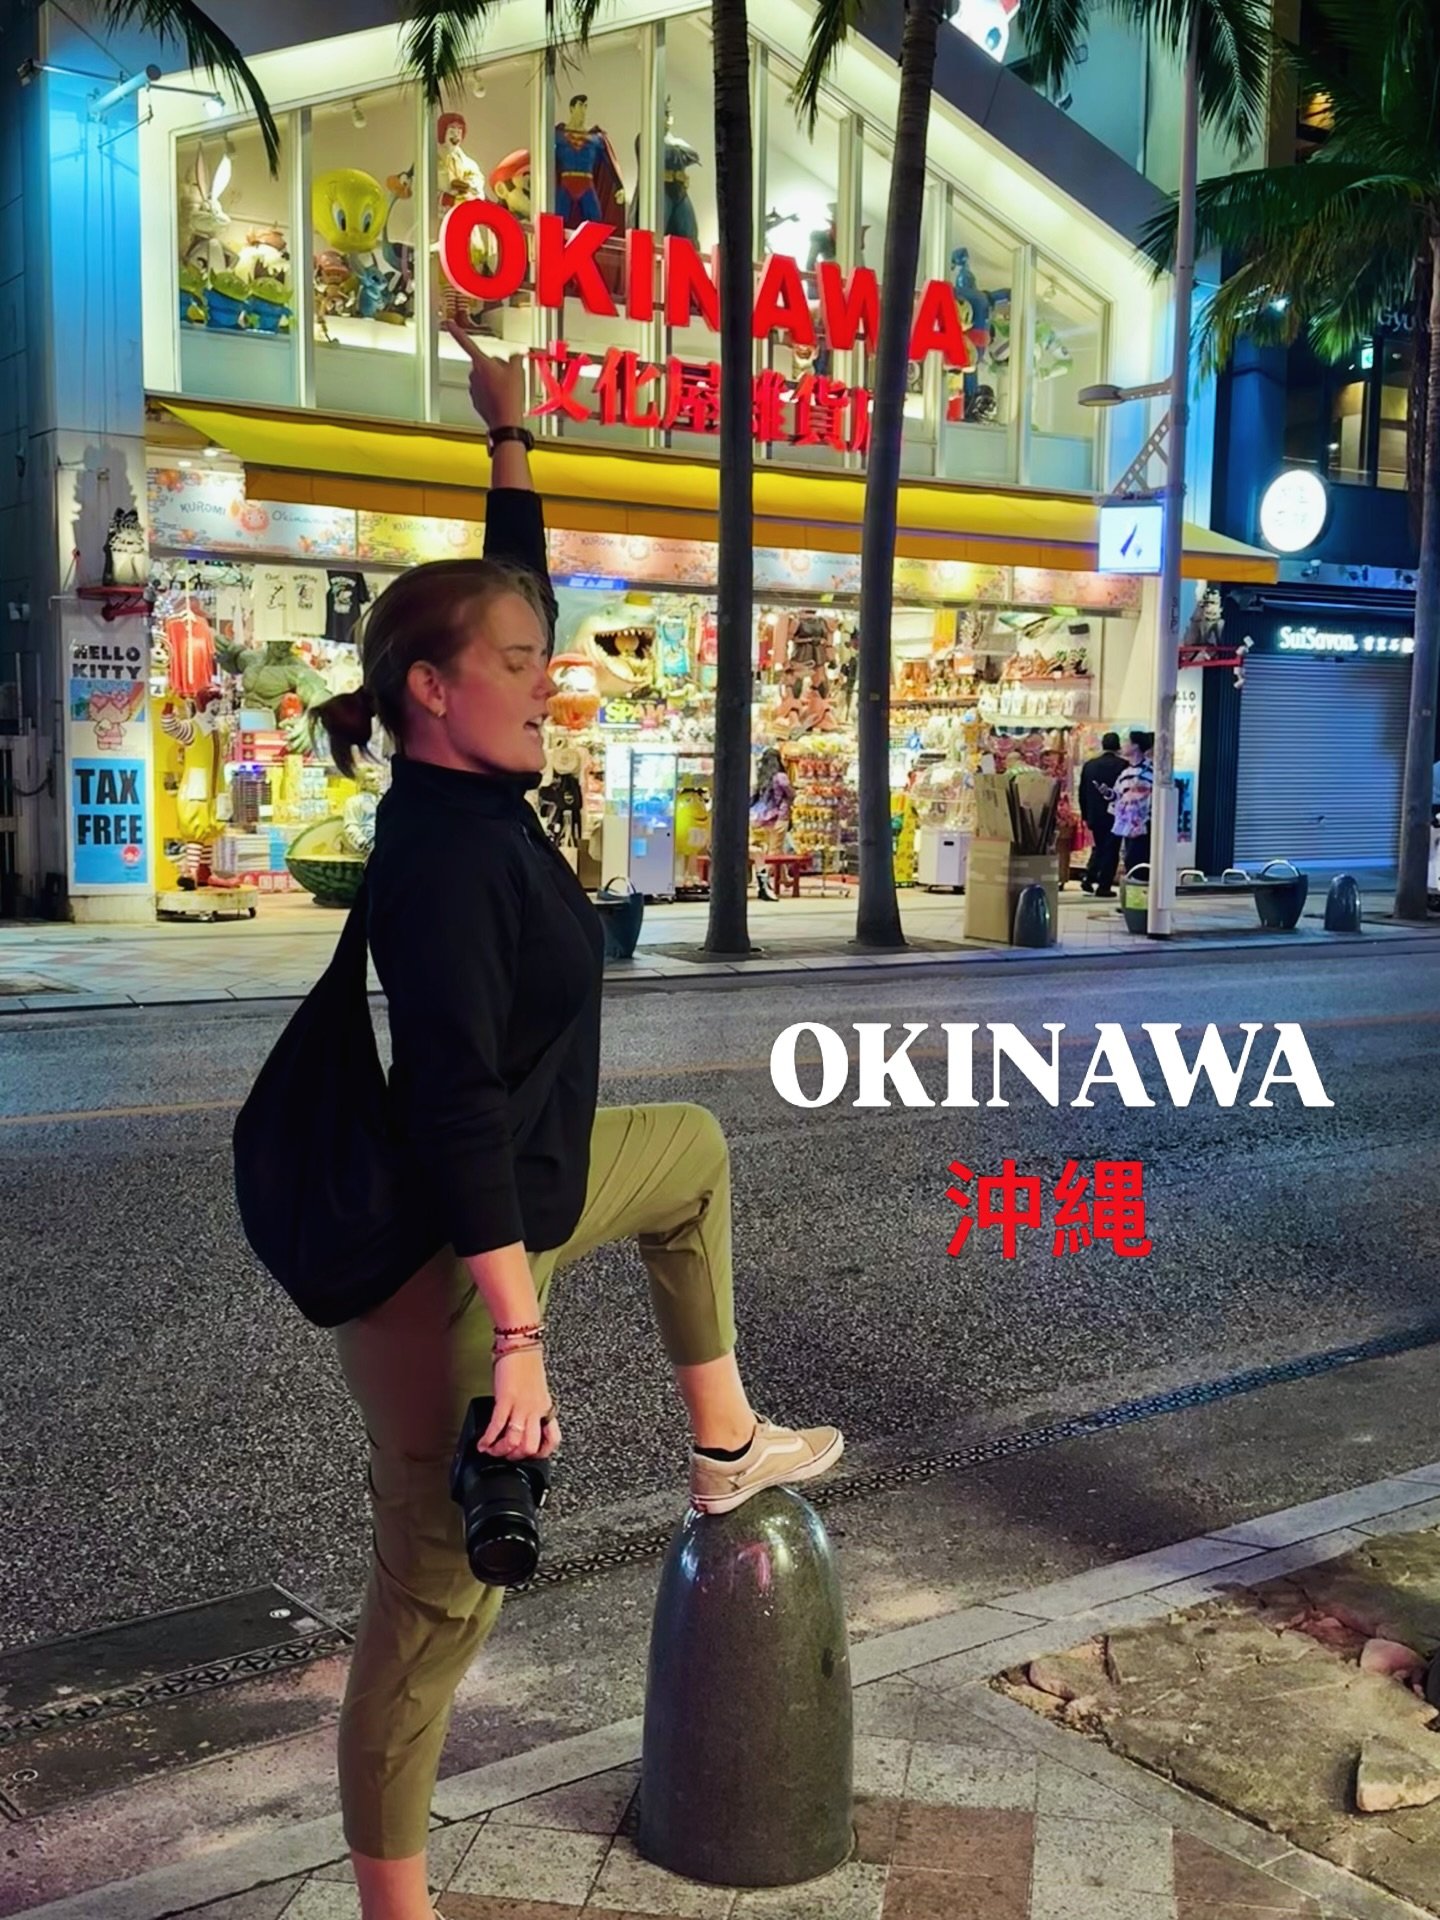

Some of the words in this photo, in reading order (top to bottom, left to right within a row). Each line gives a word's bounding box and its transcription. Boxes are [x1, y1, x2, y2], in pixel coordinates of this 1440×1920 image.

[440, 199, 968, 368] OKINAWA
[73, 645, 140, 662] HELLO
[72, 663, 141, 680] KITTY
[75, 769, 139, 804] TAX
[77, 814, 142, 845] FREE
